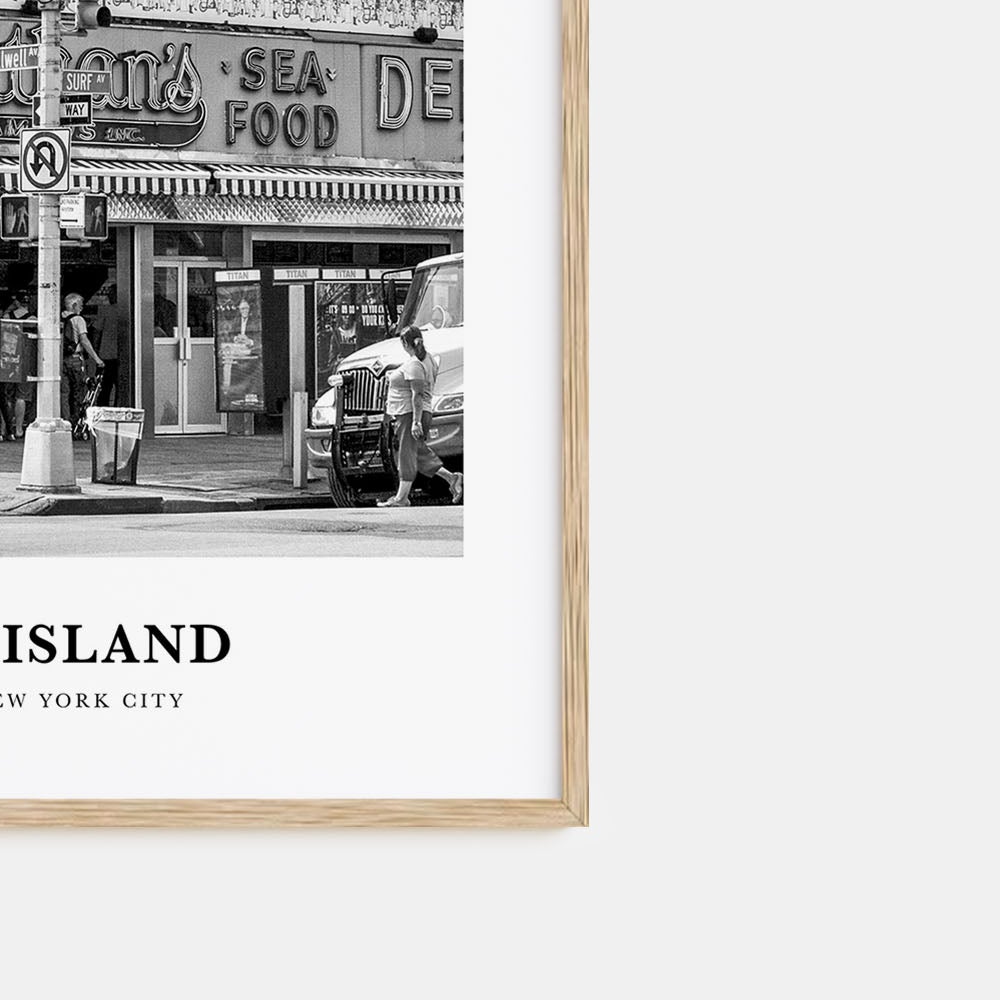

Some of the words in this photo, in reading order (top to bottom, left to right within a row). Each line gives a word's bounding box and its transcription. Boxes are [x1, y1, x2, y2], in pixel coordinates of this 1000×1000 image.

[240, 46, 327, 95] SEA
[66, 73, 93, 92] SURF
[65, 103, 85, 116] WAY
[225, 100, 339, 149] FOOD
[226, 271, 249, 281] TITAN
[286, 270, 308, 279] TITAN
[335, 270, 356, 279] TITAN
[2, 623, 231, 664] ISLAND
[40, 692, 110, 709] YORK
[122, 692, 184, 709] CITY
